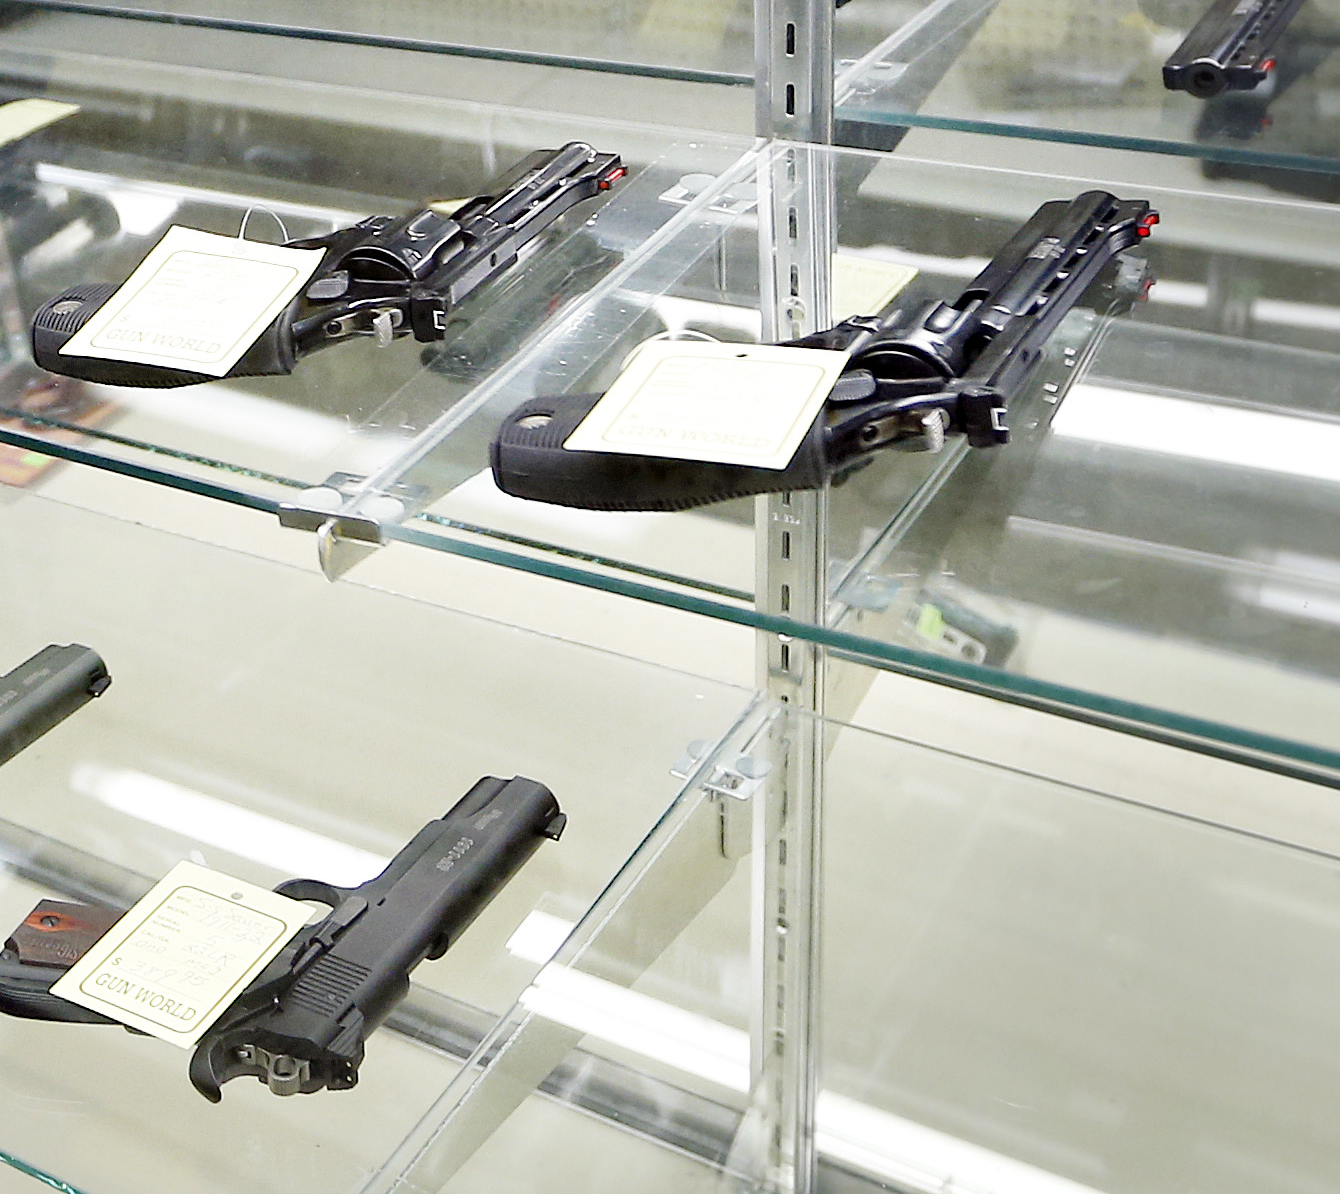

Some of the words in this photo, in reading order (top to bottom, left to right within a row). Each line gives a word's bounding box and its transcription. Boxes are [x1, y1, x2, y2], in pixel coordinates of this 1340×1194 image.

[106, 328, 150, 343] GUN
[152, 333, 222, 354] WORLD
[95, 972, 136, 996] GUN
[135, 986, 197, 1022] WORLD
